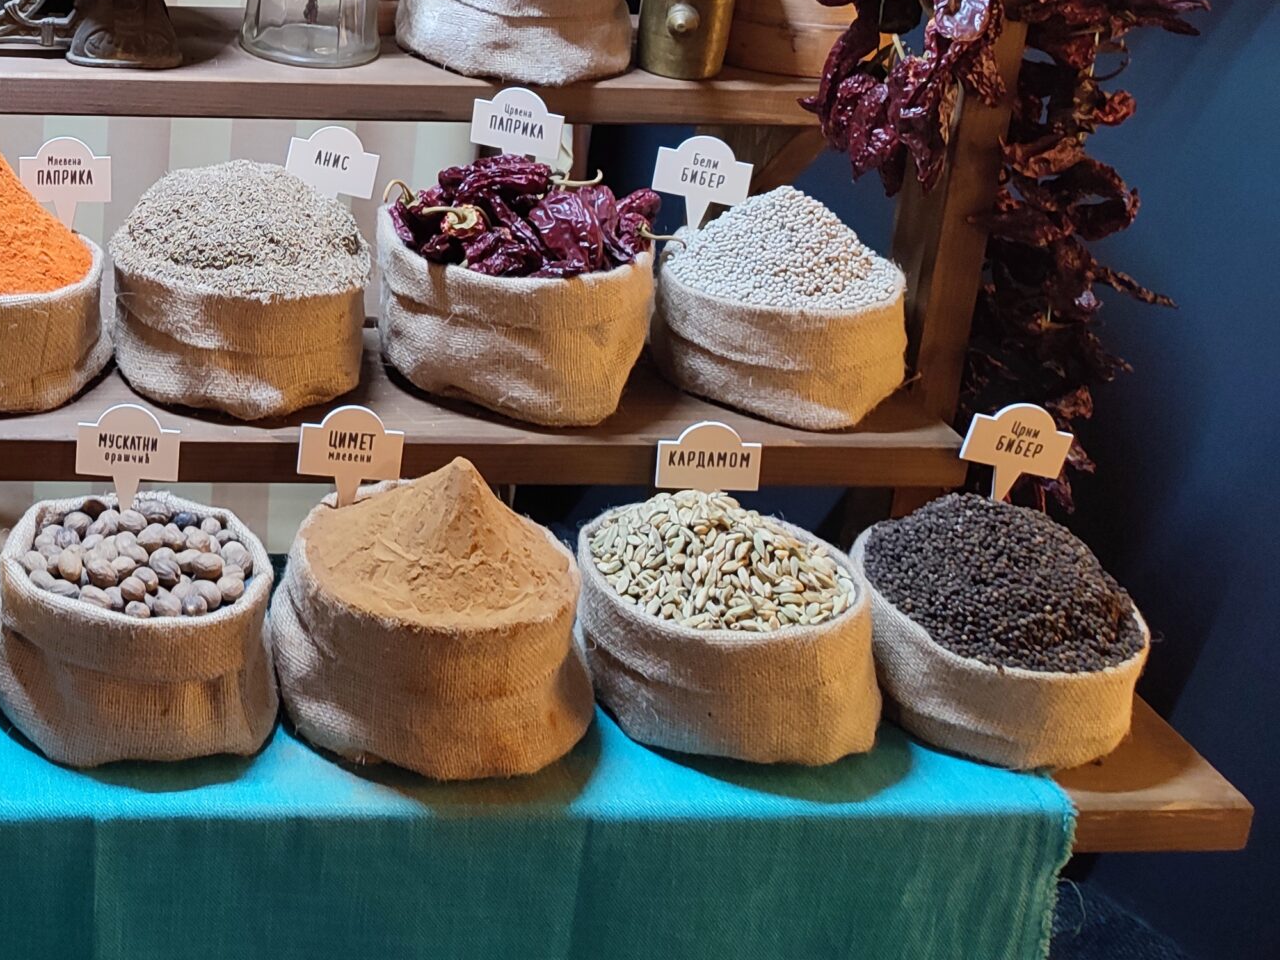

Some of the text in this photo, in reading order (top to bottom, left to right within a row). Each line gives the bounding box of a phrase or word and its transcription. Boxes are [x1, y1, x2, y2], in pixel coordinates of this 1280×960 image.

[504, 102, 533, 119] Црвена
[489, 114, 544, 140] ПАПРИКА
[46, 155, 82, 167] Млевена
[314, 149, 350, 172] АНИС
[692, 152, 720, 170] Бели
[37, 168, 94, 186] ПАПРИКА
[680, 167, 726, 189] БИБЕР
[1010, 419, 1041, 440] Црни
[98, 432, 158, 452] МУСКАТНИ
[328, 429, 377, 452] ЦИМЕТ
[995, 434, 1044, 459] БИБЕР
[328, 451, 372, 464] млевени
[668, 447, 751, 469] КАРДАМОМ
